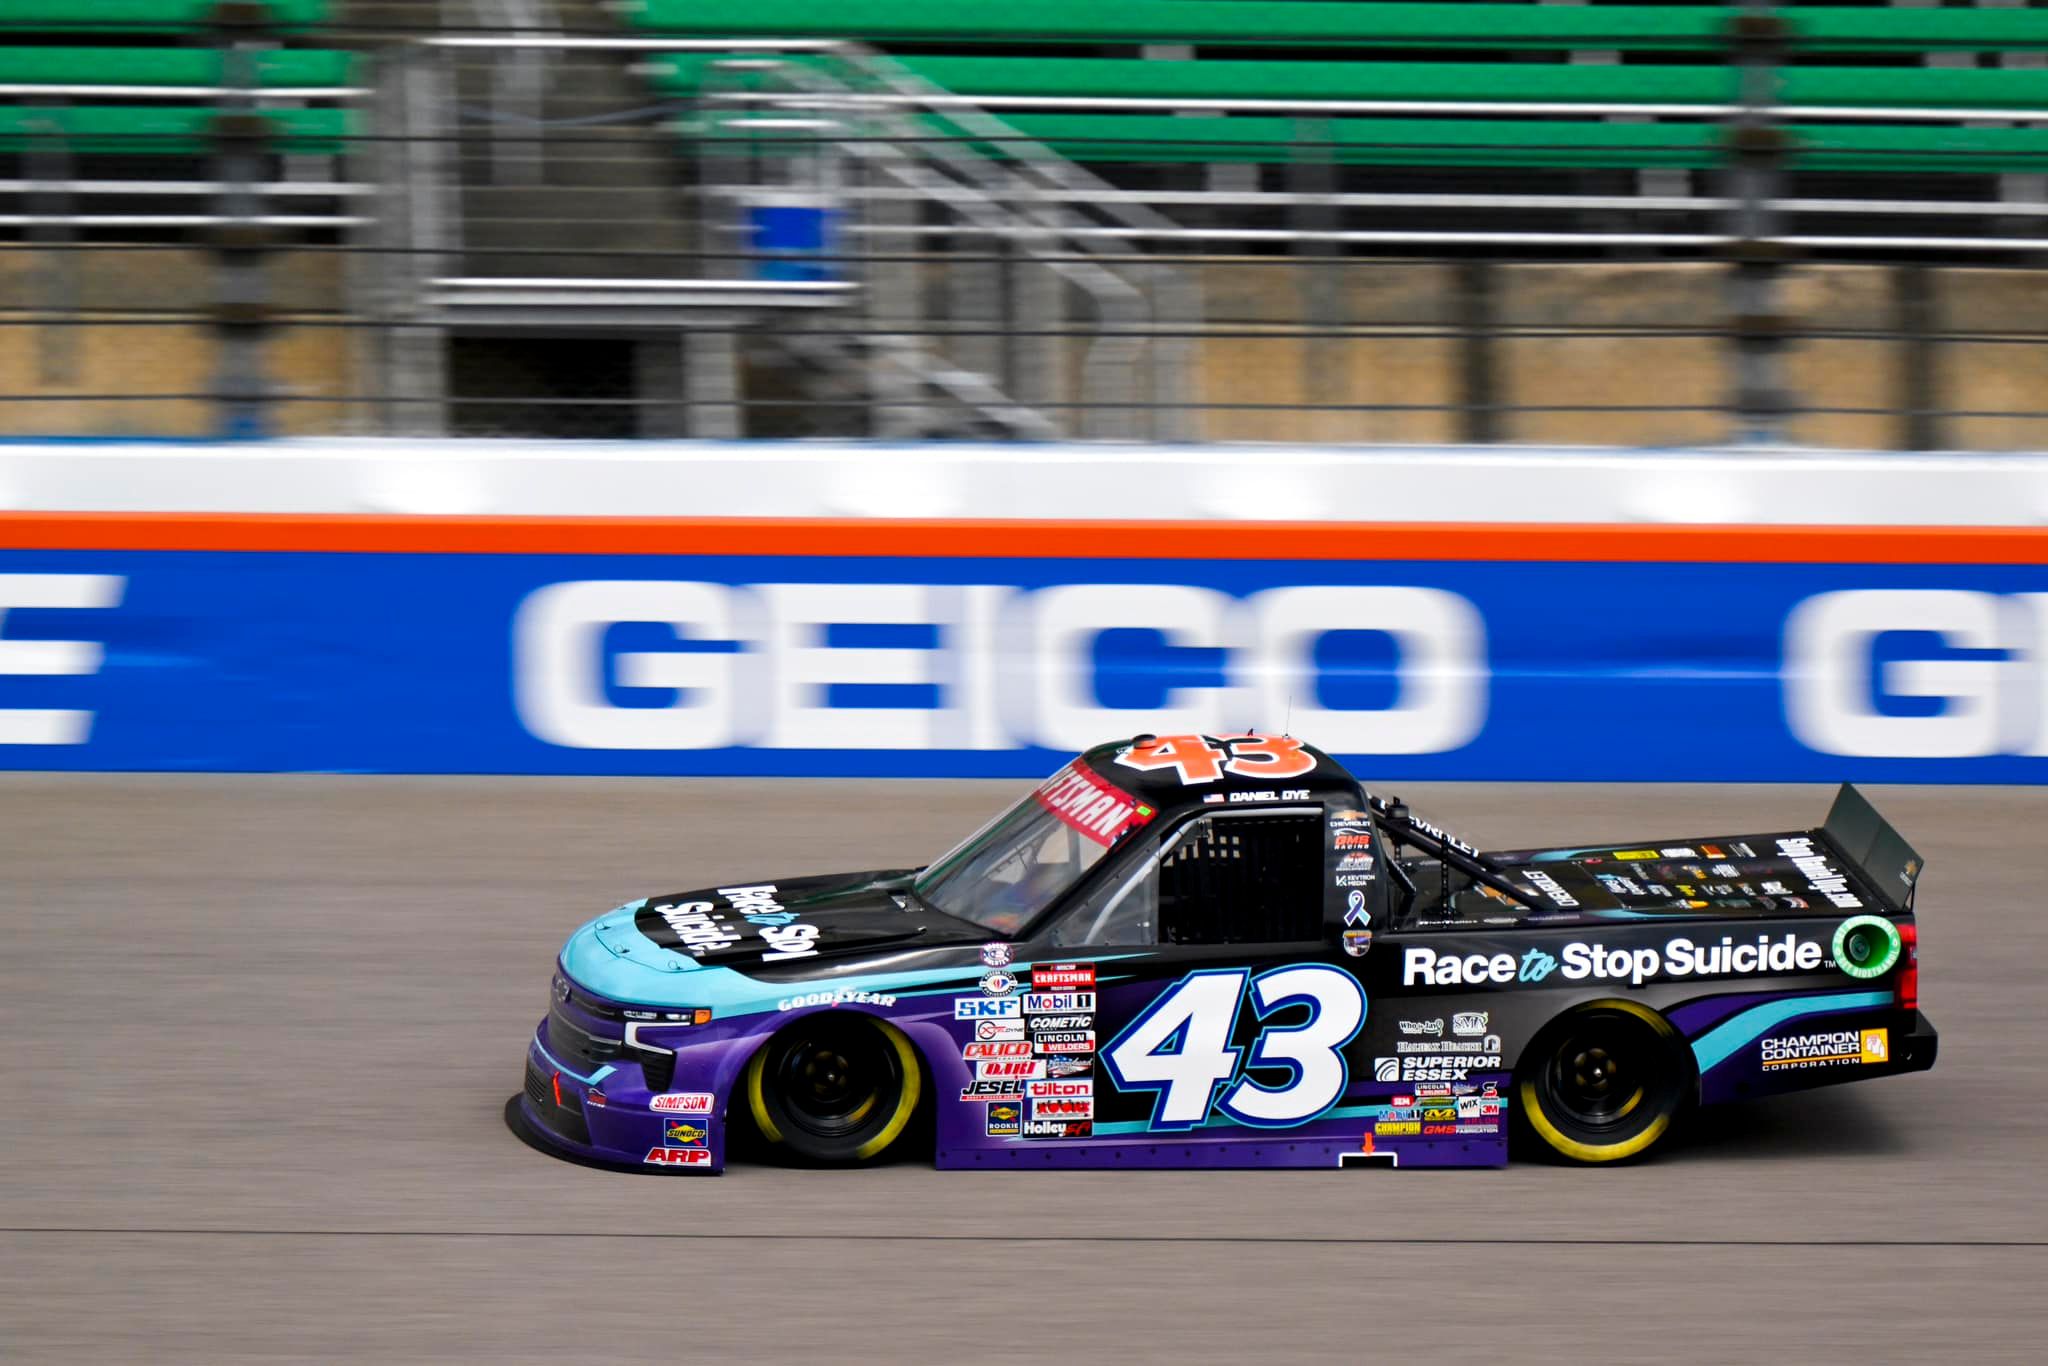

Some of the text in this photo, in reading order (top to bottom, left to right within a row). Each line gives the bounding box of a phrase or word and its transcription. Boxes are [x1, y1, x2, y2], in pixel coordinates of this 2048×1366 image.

[512, 579, 1490, 757] GEICO
[1779, 588, 2048, 758] G
[1114, 733, 1316, 785] 43
[1230, 789, 1310, 802] DANIEL DYE
[655, 901, 742, 954] Suicide
[1404, 948, 1515, 985] Race
[1518, 946, 1558, 982] to
[1562, 942, 1659, 984] Stop
[1665, 934, 1822, 980] Suicide
[1034, 973, 1091, 983] CRAFTSMAN
[778, 987, 896, 1012] GOODYEAR
[1028, 995, 1072, 1009] Mobil
[958, 1000, 1017, 1016] SKF
[1030, 1015, 1092, 1028] COMETIC
[1037, 1034, 1085, 1042] LINCOLN
[1762, 1031, 1859, 1050] CHAMPION
[965, 1044, 1030, 1056] CALICO
[1048, 1043, 1090, 1051] WELDERS
[1105, 965, 1365, 1128] 43
[1762, 1043, 1861, 1061] CONTAINER
[1402, 1056, 1501, 1069] SUPERIOR
[1762, 1058, 1861, 1071] CORPORATION
[1402, 1069, 1468, 1081] ESSEX
[962, 1081, 1023, 1095] JESEL
[1031, 1083, 1089, 1095] tilton
[655, 1096, 709, 1110] SIMPSON
[1460, 1100, 1478, 1110] WIX
[1483, 1104, 1497, 1113] 3M
[667, 1129, 705, 1137] SUNOCO
[1023, 1121, 1067, 1136] Holley
[1424, 1126, 1456, 1134] GMS
[647, 1149, 710, 1163] ARP
